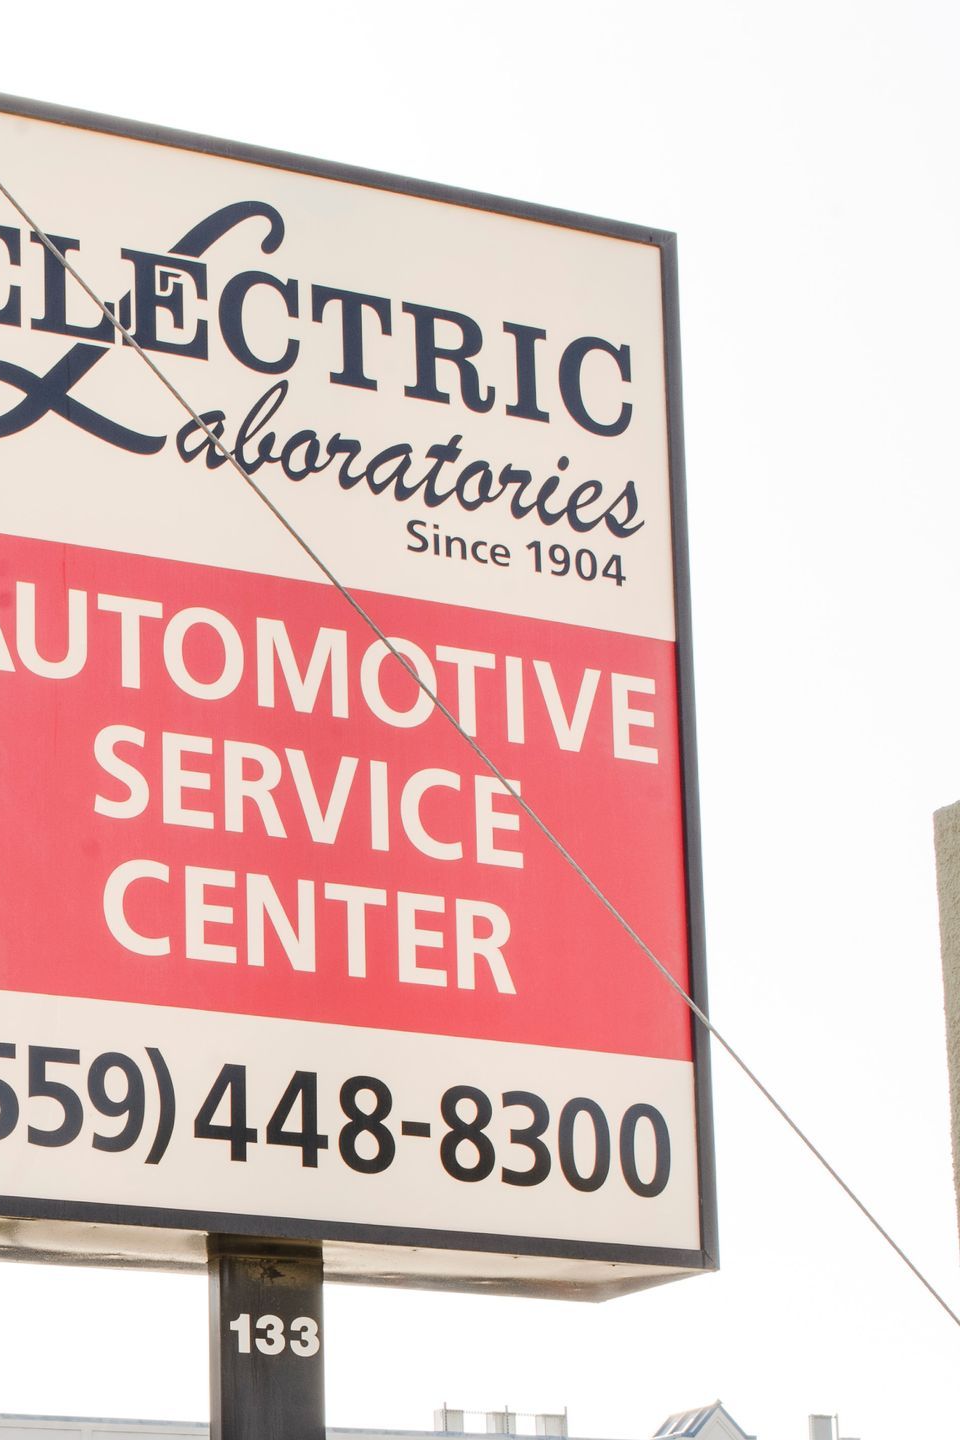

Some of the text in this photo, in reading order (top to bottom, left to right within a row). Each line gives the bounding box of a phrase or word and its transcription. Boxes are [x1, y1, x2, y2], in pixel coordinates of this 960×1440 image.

[406, 518, 627, 587] Since 1904
[93, 725, 525, 870] SERVICE
[102, 859, 517, 995] CENTER
[193, 1063, 672, 1198] 448-8300
[230, 1313, 321, 1357] 133
